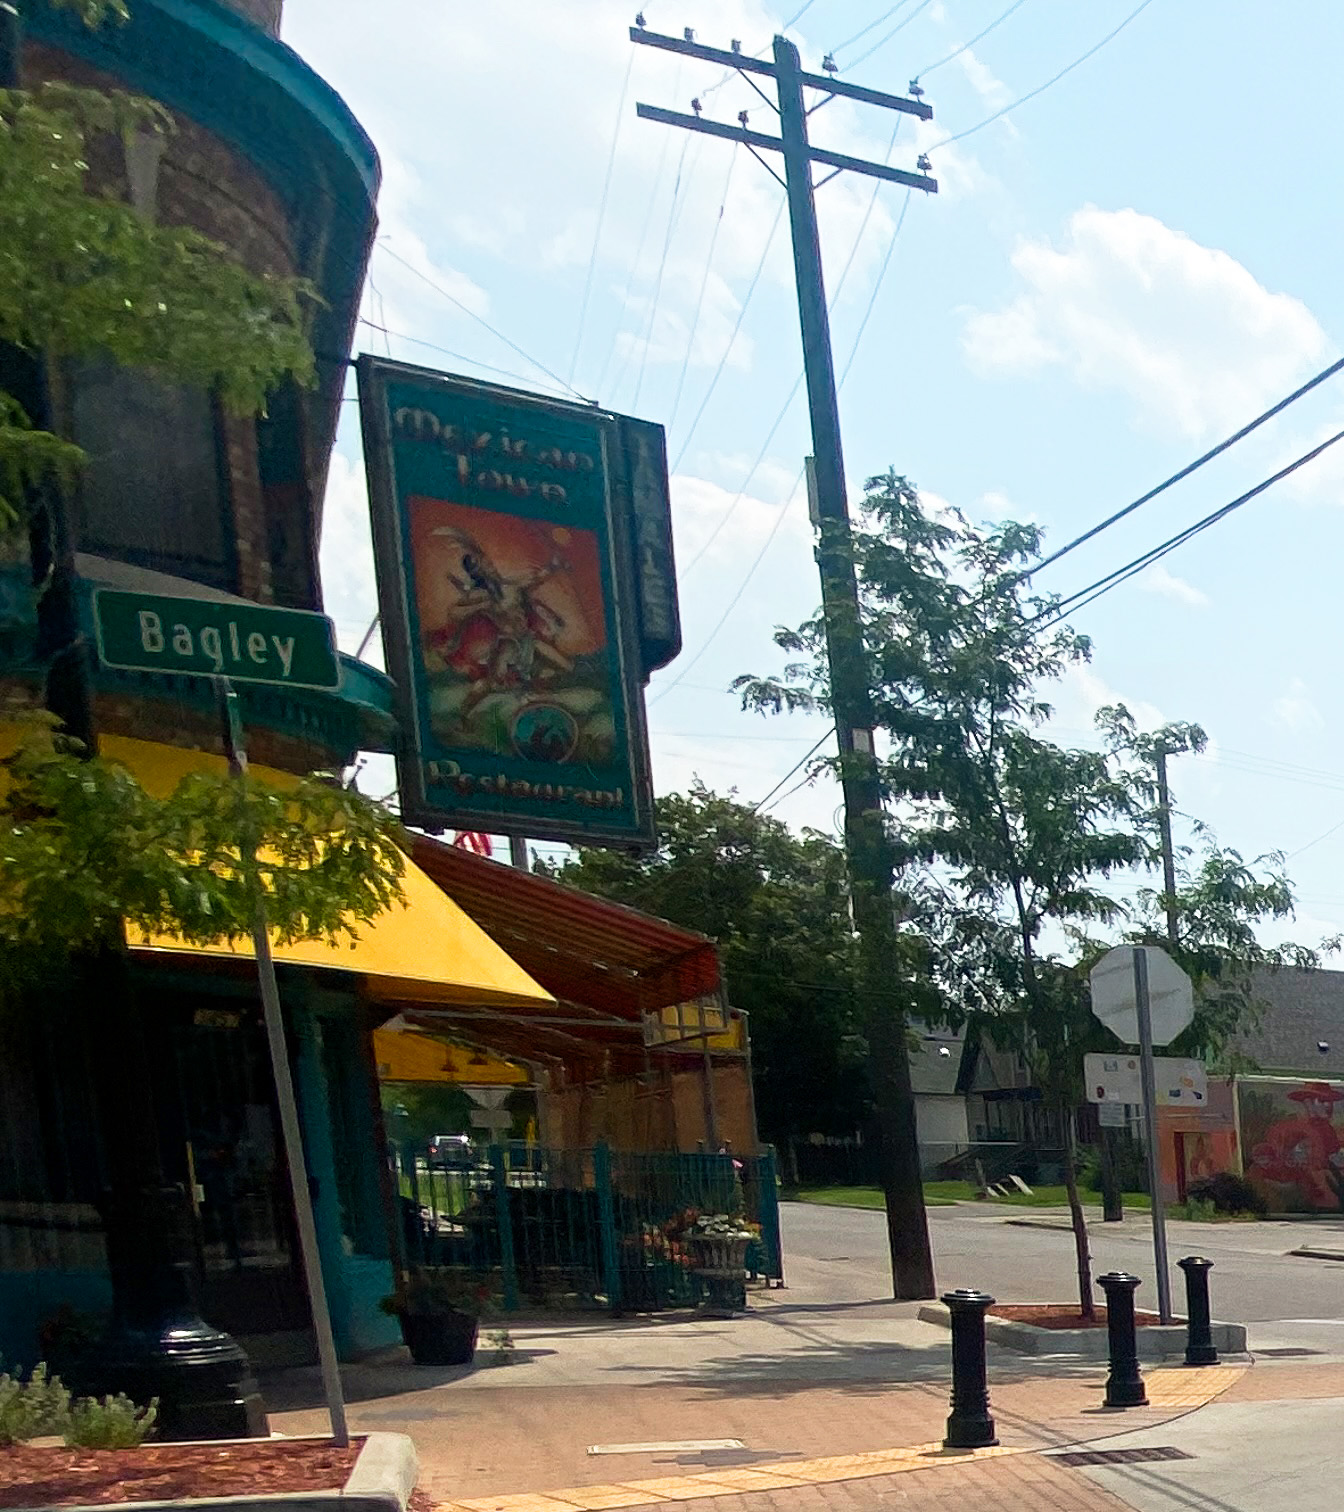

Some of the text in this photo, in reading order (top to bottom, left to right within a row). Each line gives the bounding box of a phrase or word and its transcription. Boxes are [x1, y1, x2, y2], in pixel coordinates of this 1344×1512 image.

[394, 406, 595, 472] Mexican
[450, 450, 567, 503] Town
[138, 610, 296, 678] Bagley
[428, 759, 624, 811] Restaurant
